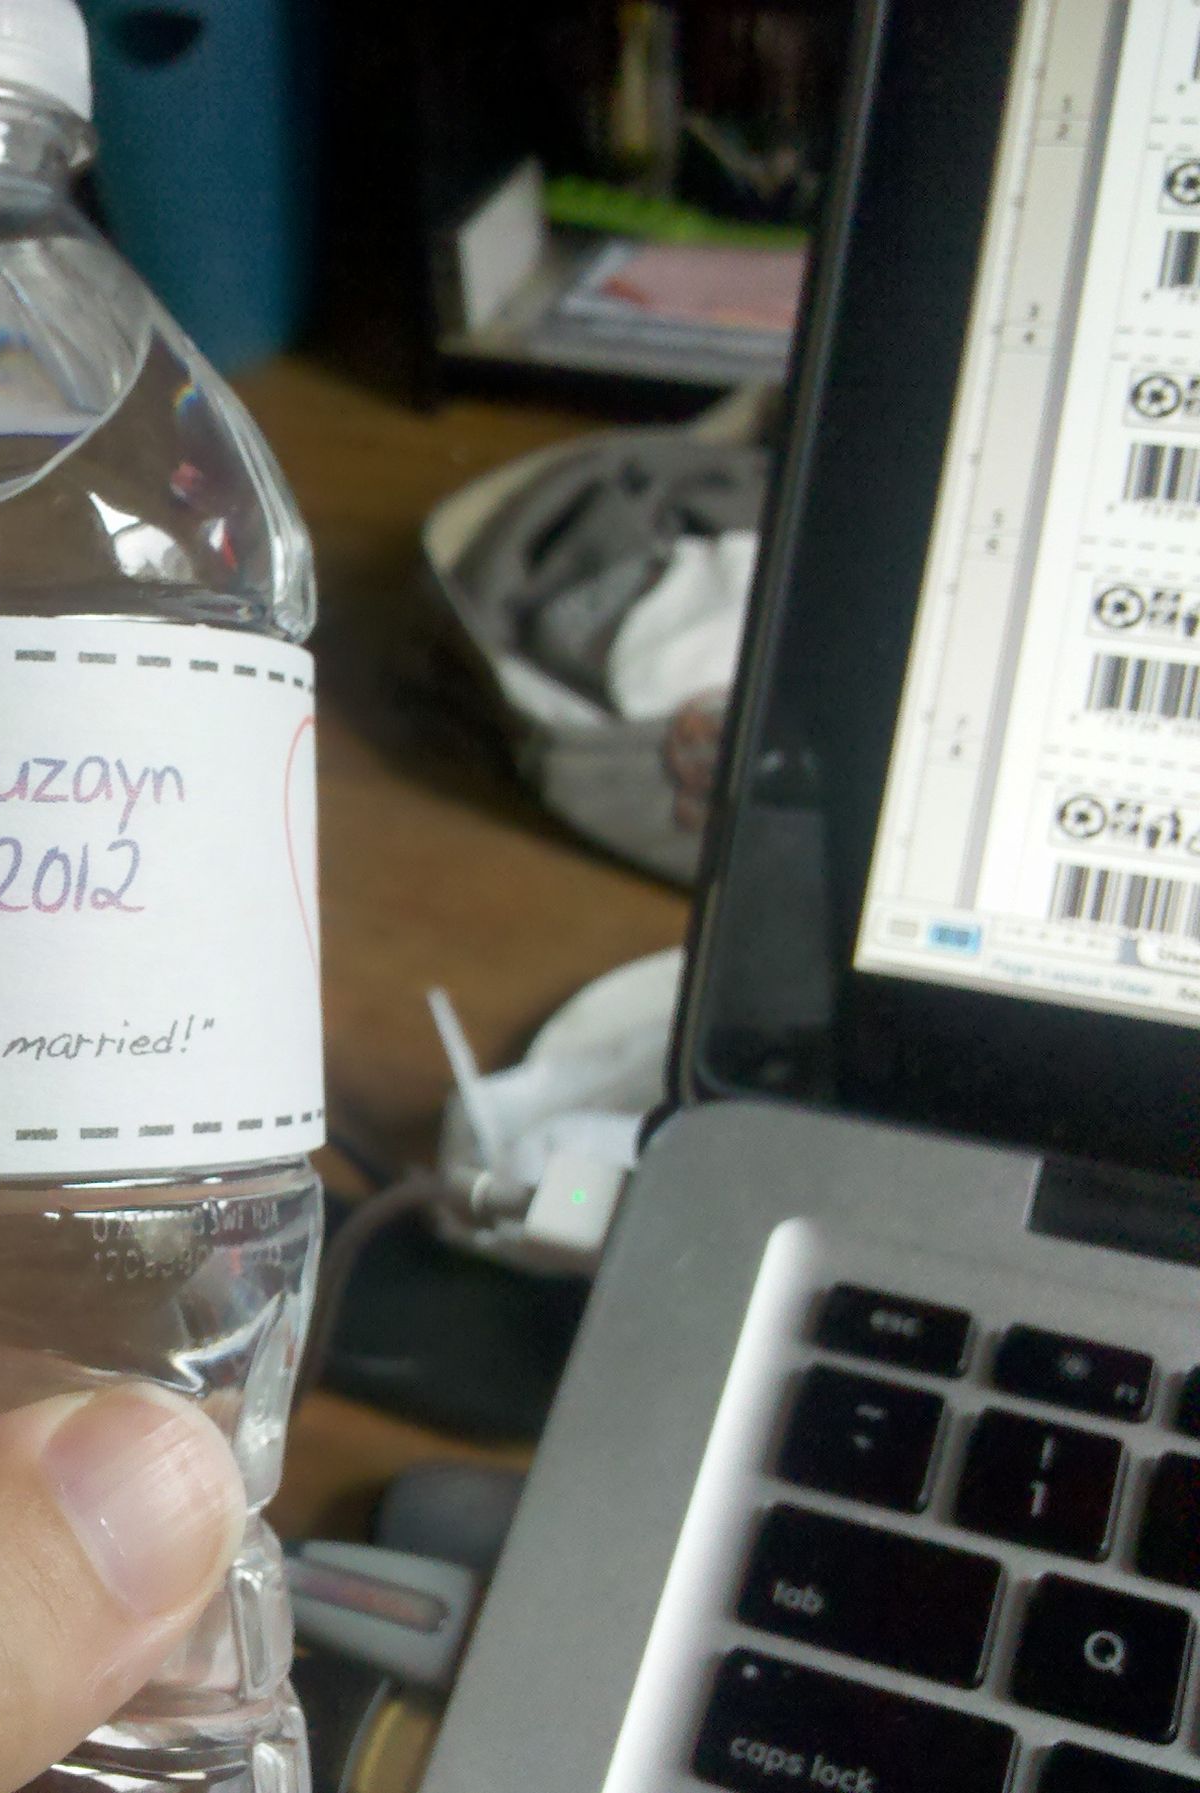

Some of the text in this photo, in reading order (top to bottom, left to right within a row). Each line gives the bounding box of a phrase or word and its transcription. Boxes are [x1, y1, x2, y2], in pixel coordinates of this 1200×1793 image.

[1084, 1630, 1128, 1675] Q
[730, 1737, 877, 1793] caps lock
